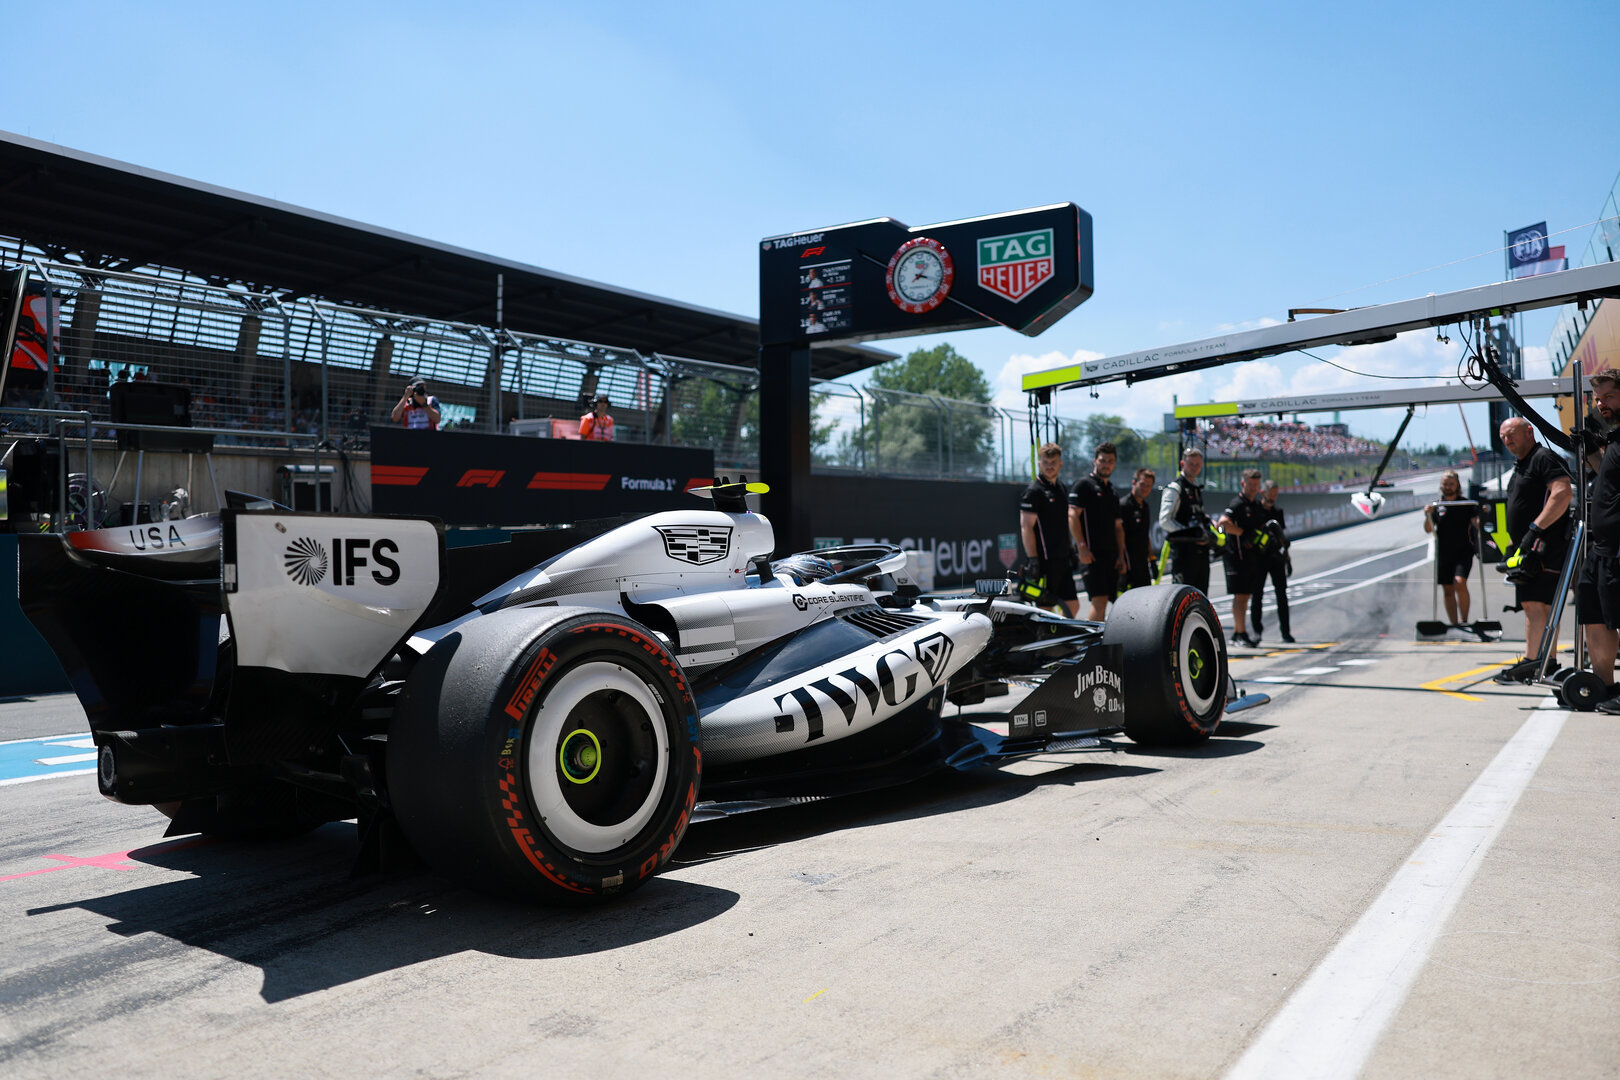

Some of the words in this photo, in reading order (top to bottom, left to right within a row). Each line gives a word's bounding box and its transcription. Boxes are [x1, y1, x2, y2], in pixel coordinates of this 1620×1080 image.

[773, 233, 824, 249] TAGHeuer
[983, 235, 1046, 261] TAG
[982, 261, 1049, 297] HEUER
[1103, 353, 1160, 370] CADILLAC
[1164, 347, 1198, 358] FORMULA
[1205, 342, 1226, 351] TEAM
[1260, 399, 1317, 408] CADILLAC
[621, 477, 665, 490] Formula
[129, 525, 186, 550] USA
[332, 538, 400, 586] IFS
[808, 597, 829, 605] CORE
[504, 647, 557, 720] PIRELLI
[1073, 670, 1095, 698] JIM
[1095, 665, 1121, 694] BEAM
[773, 648, 919, 744] TWG
[639, 781, 697, 880] ZERO
